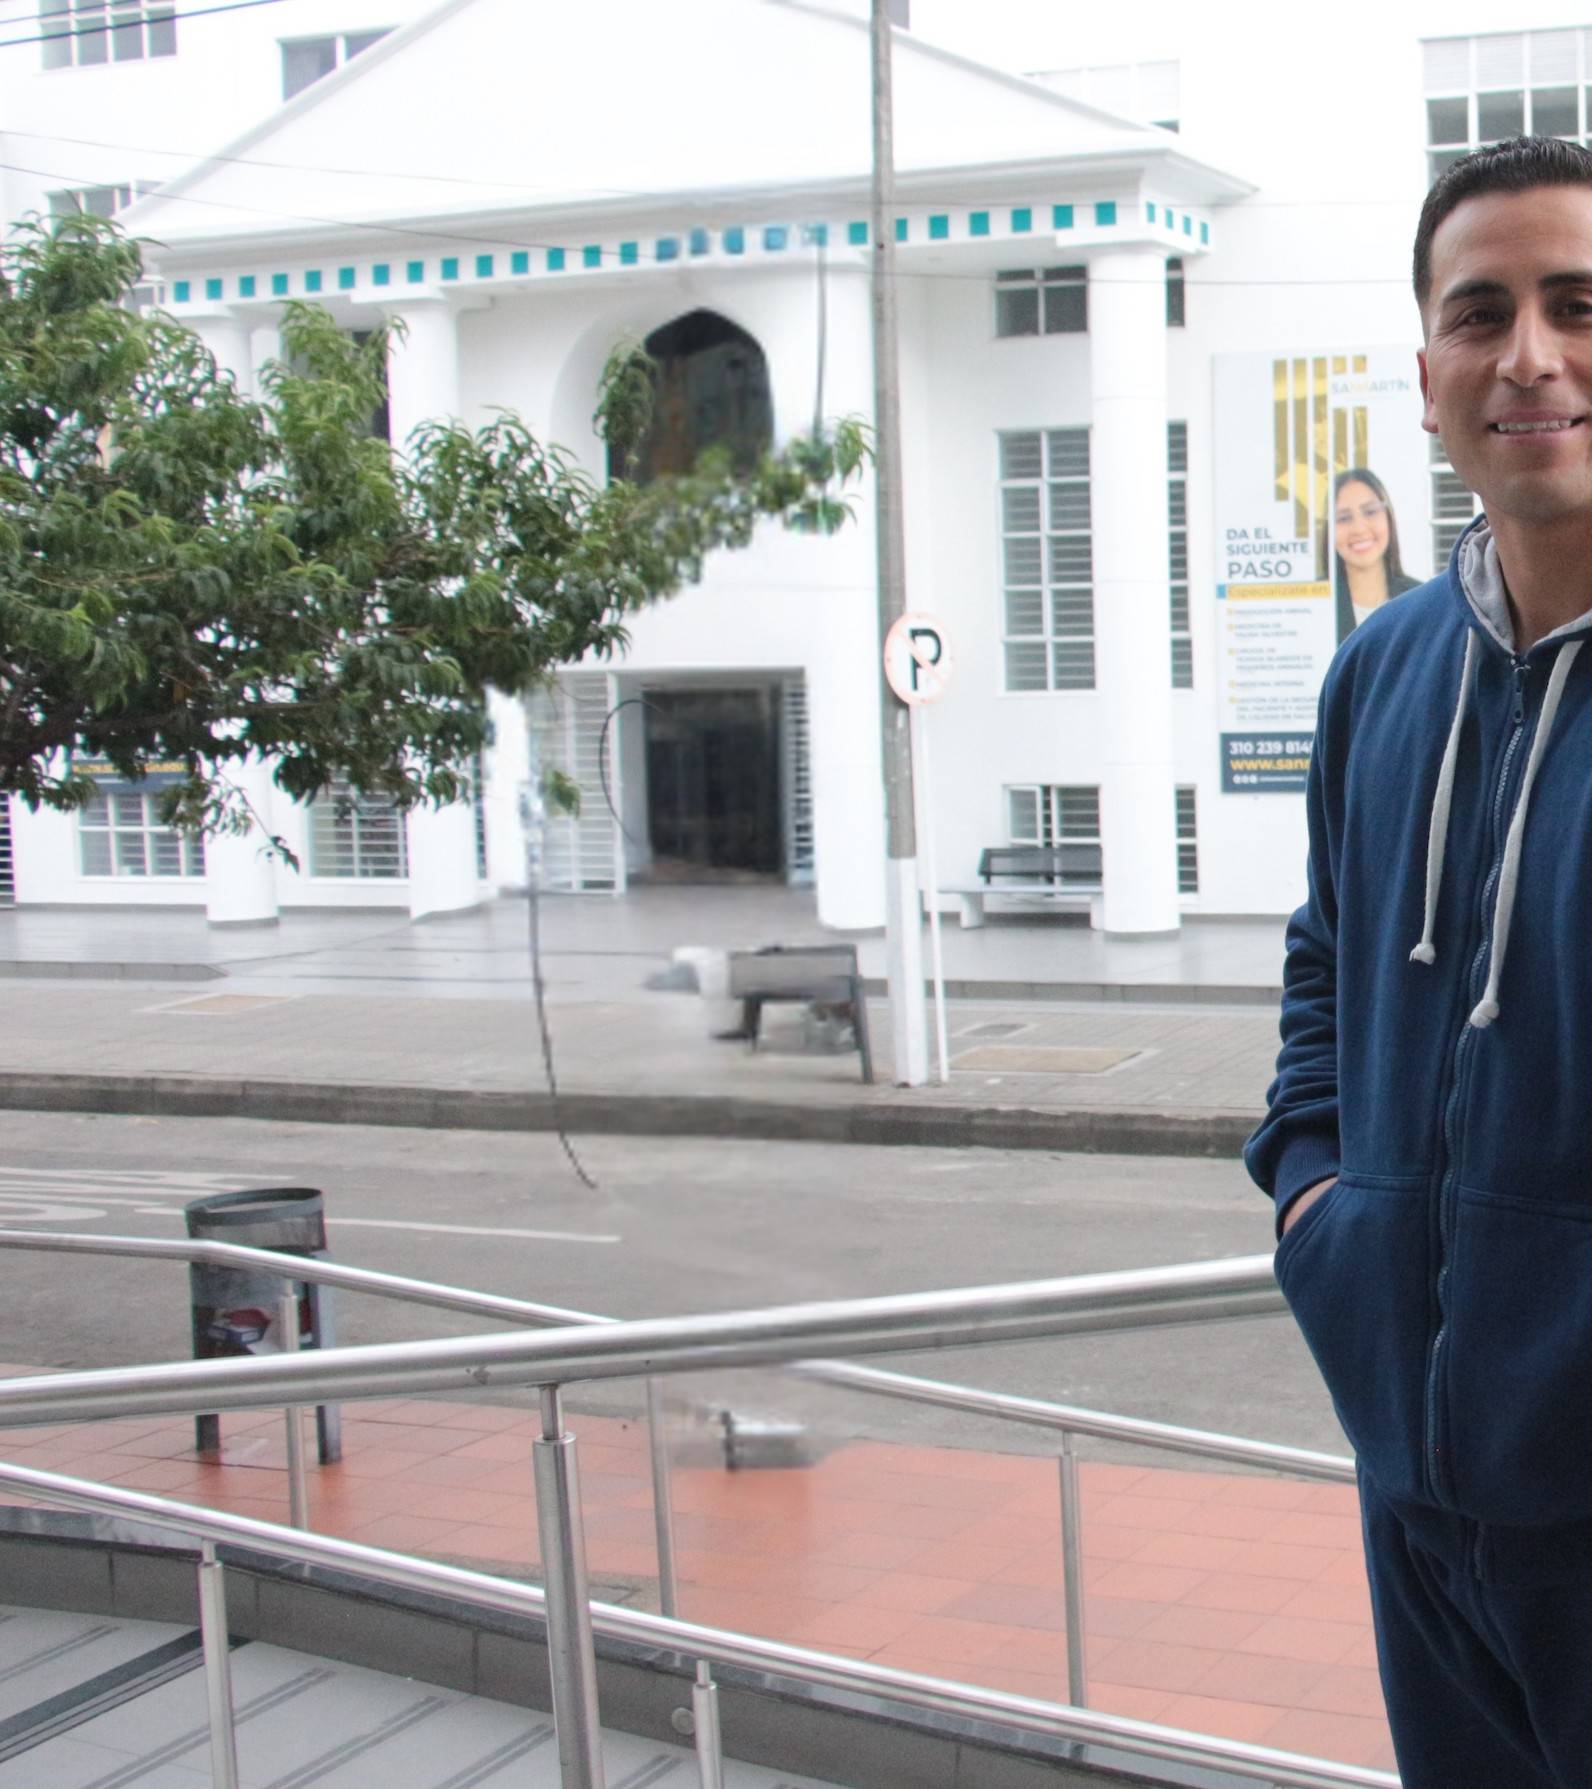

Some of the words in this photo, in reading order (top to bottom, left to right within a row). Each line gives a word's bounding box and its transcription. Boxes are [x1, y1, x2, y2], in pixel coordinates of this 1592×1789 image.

[1226, 528, 1249, 540] DA
[1254, 527, 1272, 539] EL
[1226, 542, 1309, 556] SIGUIENTE
[1228, 560, 1292, 578] PASO
[909, 628, 942, 691] P
[1229, 741, 1254, 755] 310
[1256, 741, 1283, 755] 239
